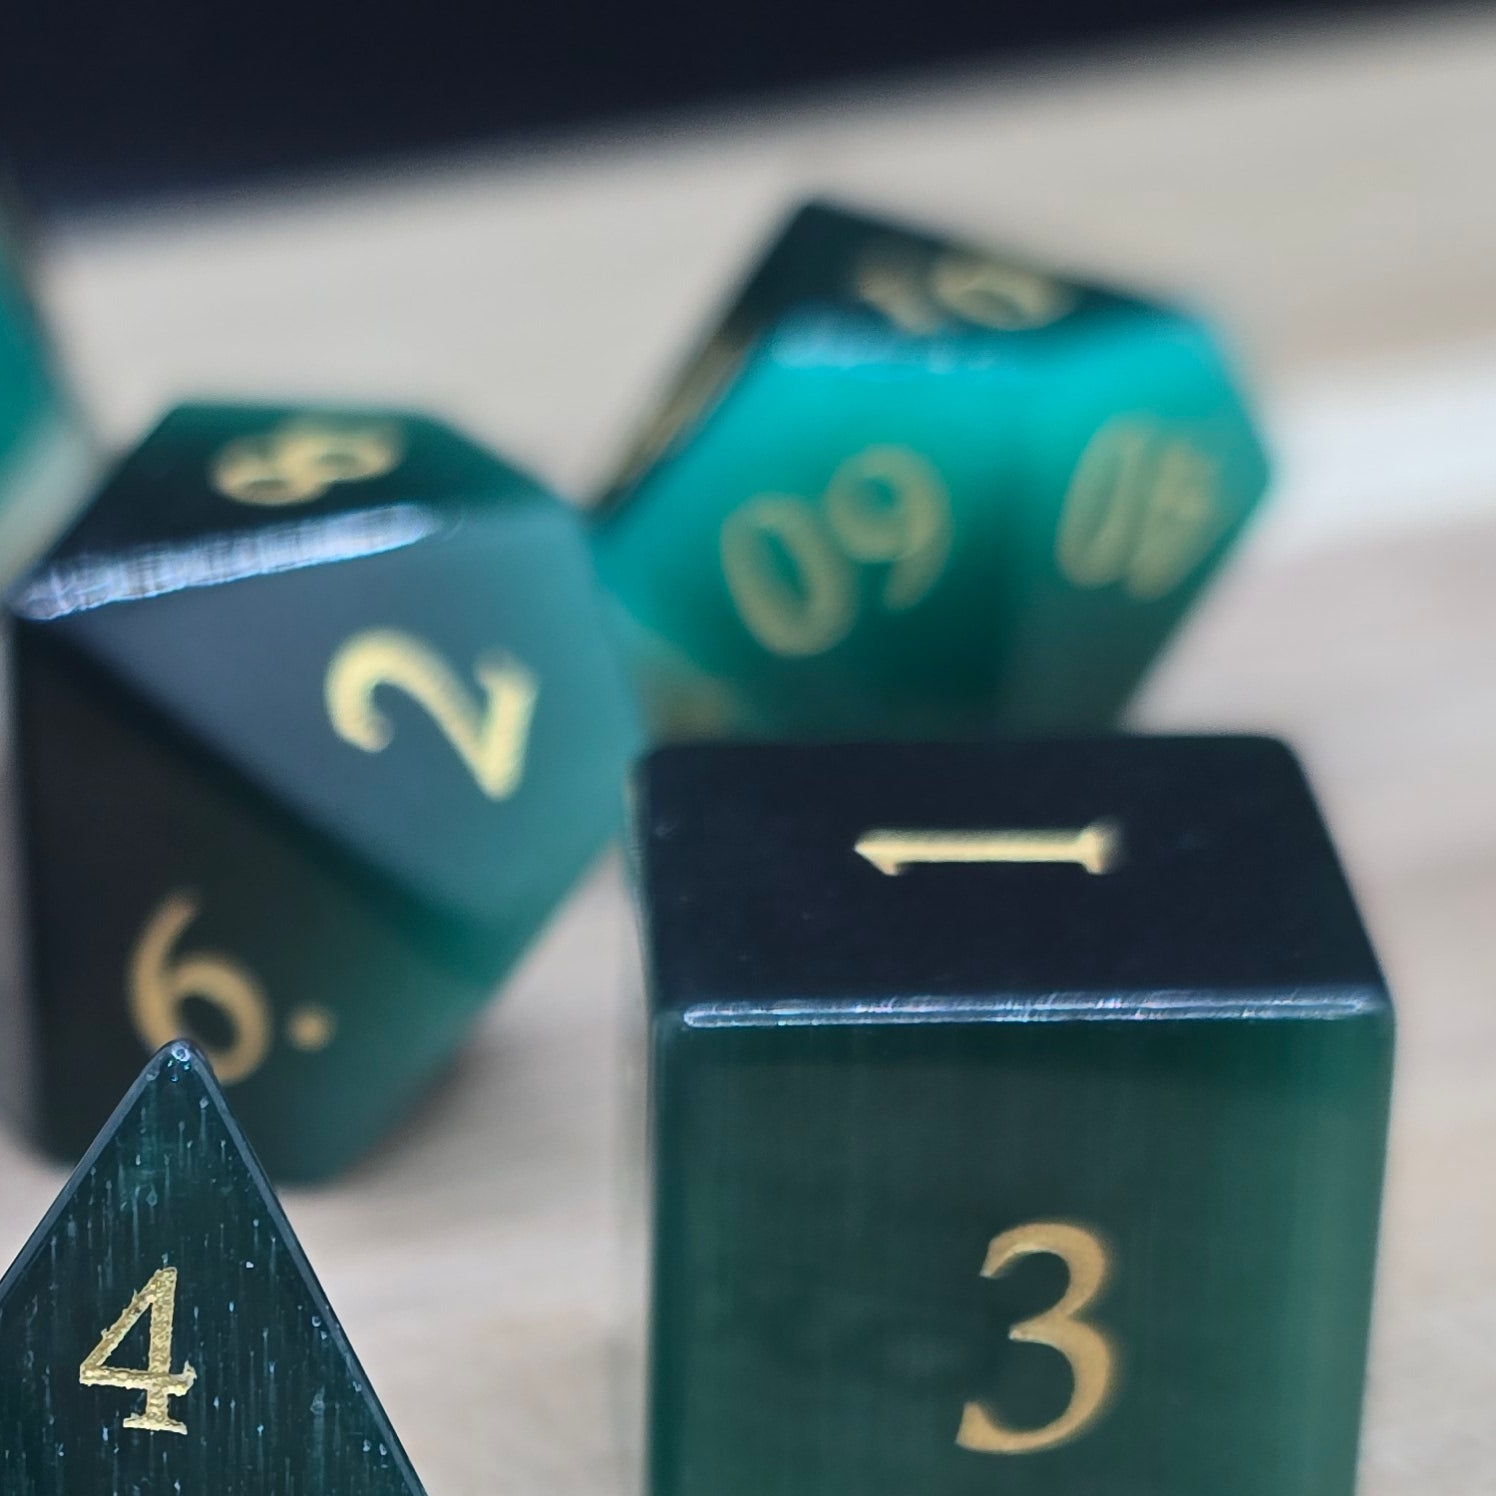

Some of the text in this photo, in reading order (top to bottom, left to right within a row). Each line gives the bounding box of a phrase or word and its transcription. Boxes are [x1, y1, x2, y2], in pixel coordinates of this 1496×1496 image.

[326, 630, 539, 798] 2
[854, 818, 1116, 876] 1
[79, 1266, 196, 1434] 4
[956, 1220, 1118, 1454] 3
